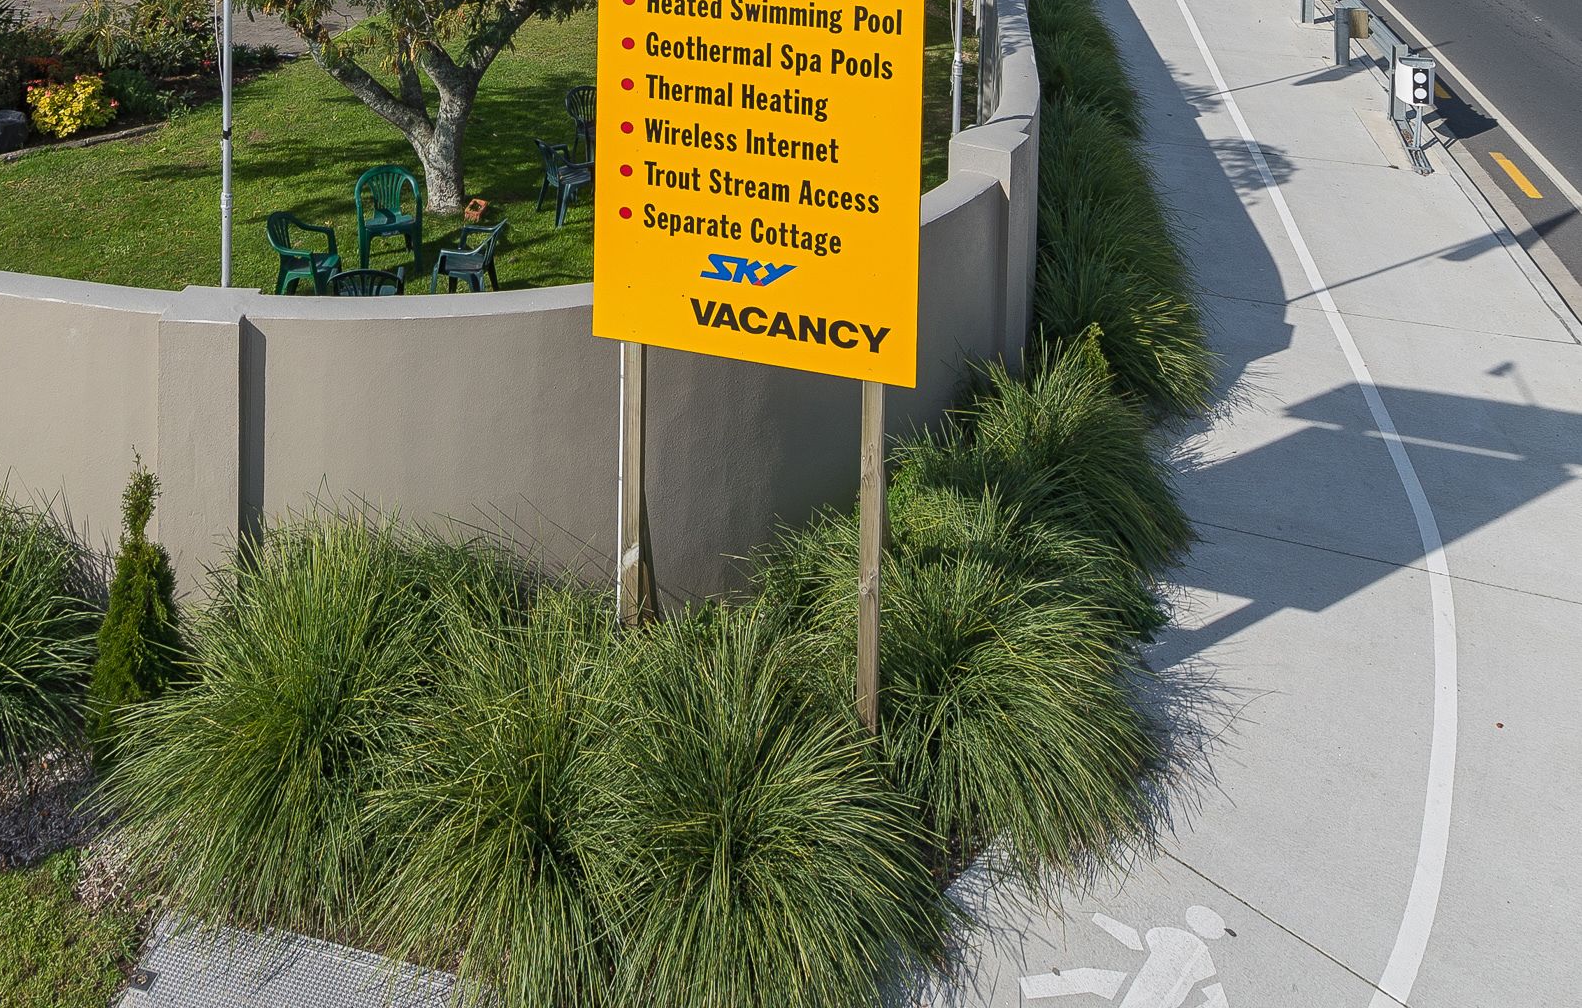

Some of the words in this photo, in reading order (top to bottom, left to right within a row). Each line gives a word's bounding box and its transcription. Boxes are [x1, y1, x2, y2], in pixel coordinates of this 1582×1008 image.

[853, 5, 903, 35] Pool
[645, 31, 772, 68] Geothermal
[780, 43, 822, 76] Spa
[830, 48, 893, 80] Pools
[645, 74, 733, 107] Thermal
[741, 83, 829, 123] Heating
[644, 117, 737, 152] Wireless
[746, 128, 839, 164] Internet
[644, 160, 701, 192] Trout
[709, 168, 790, 203] Stream
[798, 179, 880, 214] Access
[643, 203, 742, 240] Separate
[750, 217, 842, 257] Cottage
[700, 253, 798, 287] SKY
[689, 297, 891, 354] VACANCY
